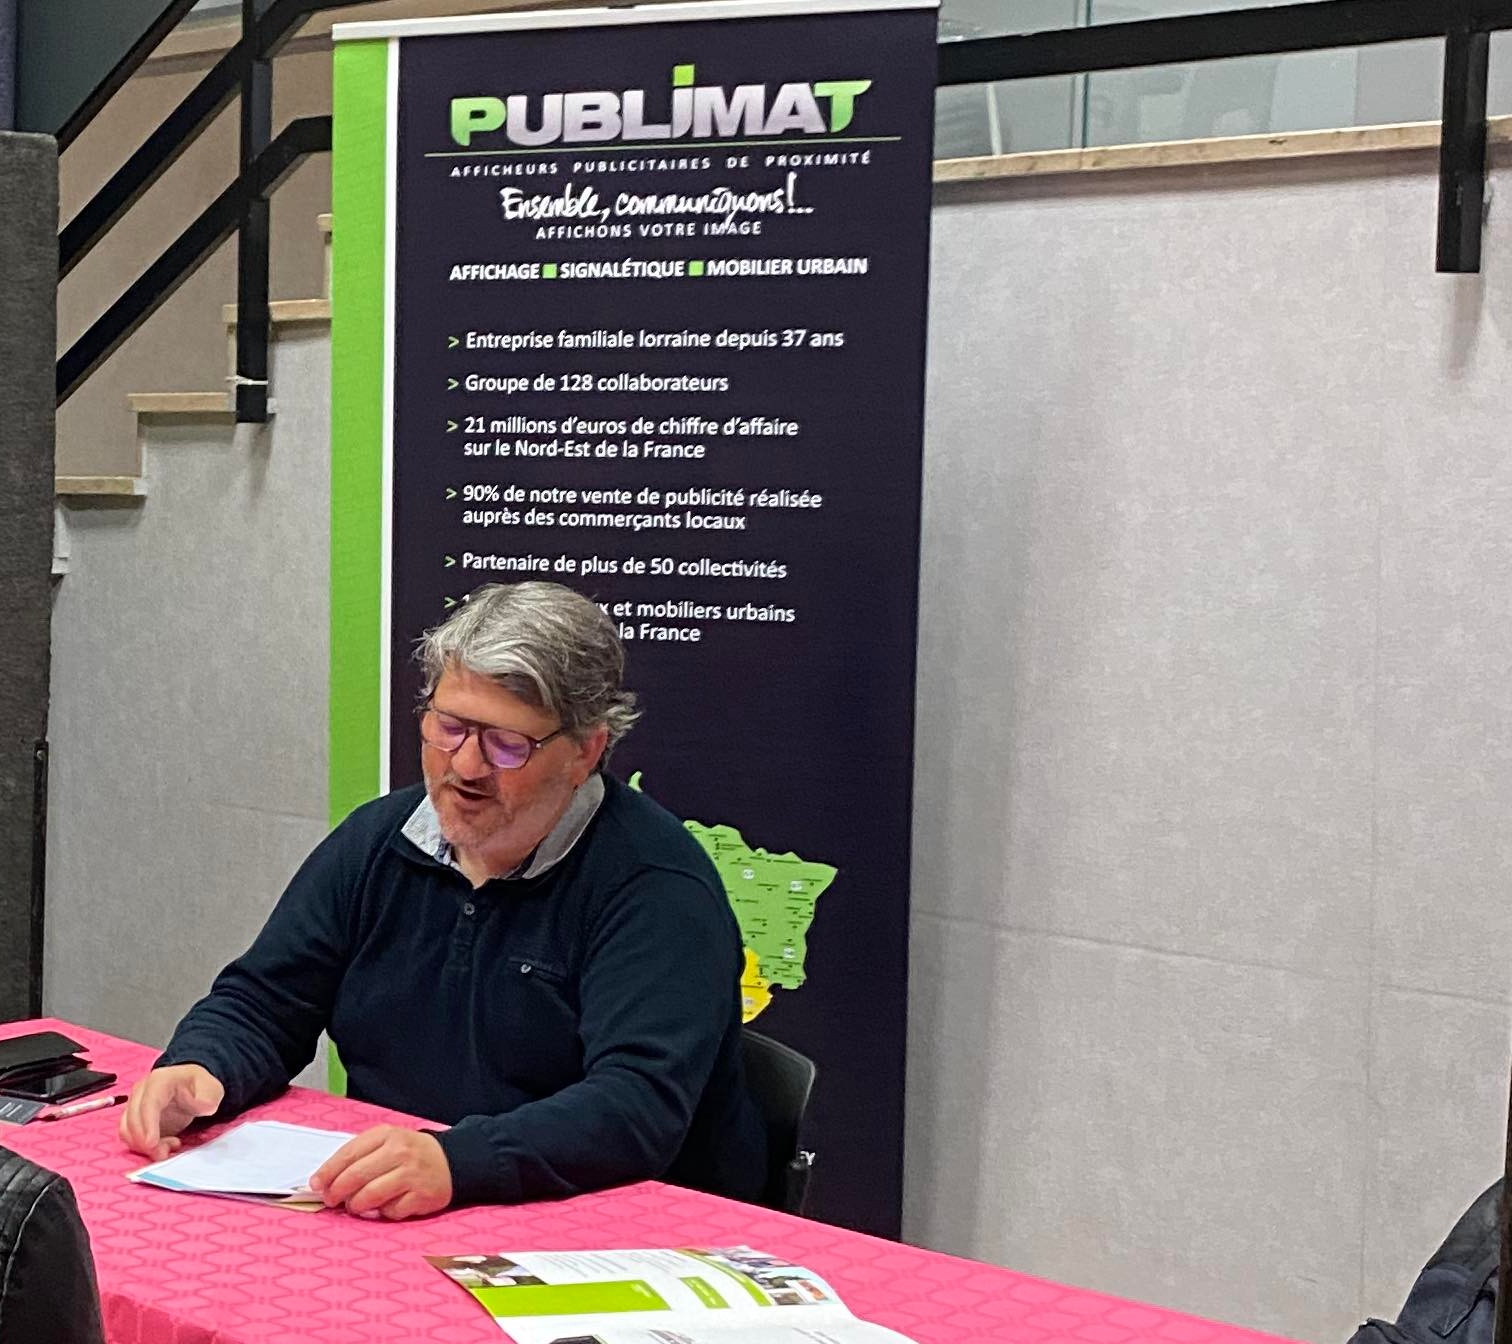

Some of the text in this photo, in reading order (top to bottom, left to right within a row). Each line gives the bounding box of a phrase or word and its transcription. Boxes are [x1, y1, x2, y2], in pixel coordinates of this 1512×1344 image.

[450, 149, 872, 178] AFFICHEURS PUBLICITAIRES DE PROXIMITÉ
[500, 183, 611, 223] Ensemble,
[535, 220, 762, 240] AFFICHONS VOTRE IMAGE
[449, 257, 868, 281] AFFICHAGE SIGNALÉTIQUE MOBILIER URBAIN
[465, 329, 845, 351] Entreprise familiale lorraine depuis 37 ans
[465, 373, 729, 394] Groupe de 128 collaborateurs
[464, 417, 486, 434] 21
[490, 416, 557, 434] millions
[631, 417, 655, 435] de
[659, 417, 719, 436] chiffre
[463, 439, 706, 459] sur le Nord-Est de la France
[462, 485, 823, 510] 90% de notre vente de publicité réalisée
[462, 507, 747, 532] auprès des commerçants locaux
[462, 552, 788, 579] Partenaire de plus de 50 collectivités
[612, 602, 633, 617] et
[636, 600, 722, 621] mobiliers
[726, 602, 796, 623] urbains
[618, 622, 701, 642] la France
